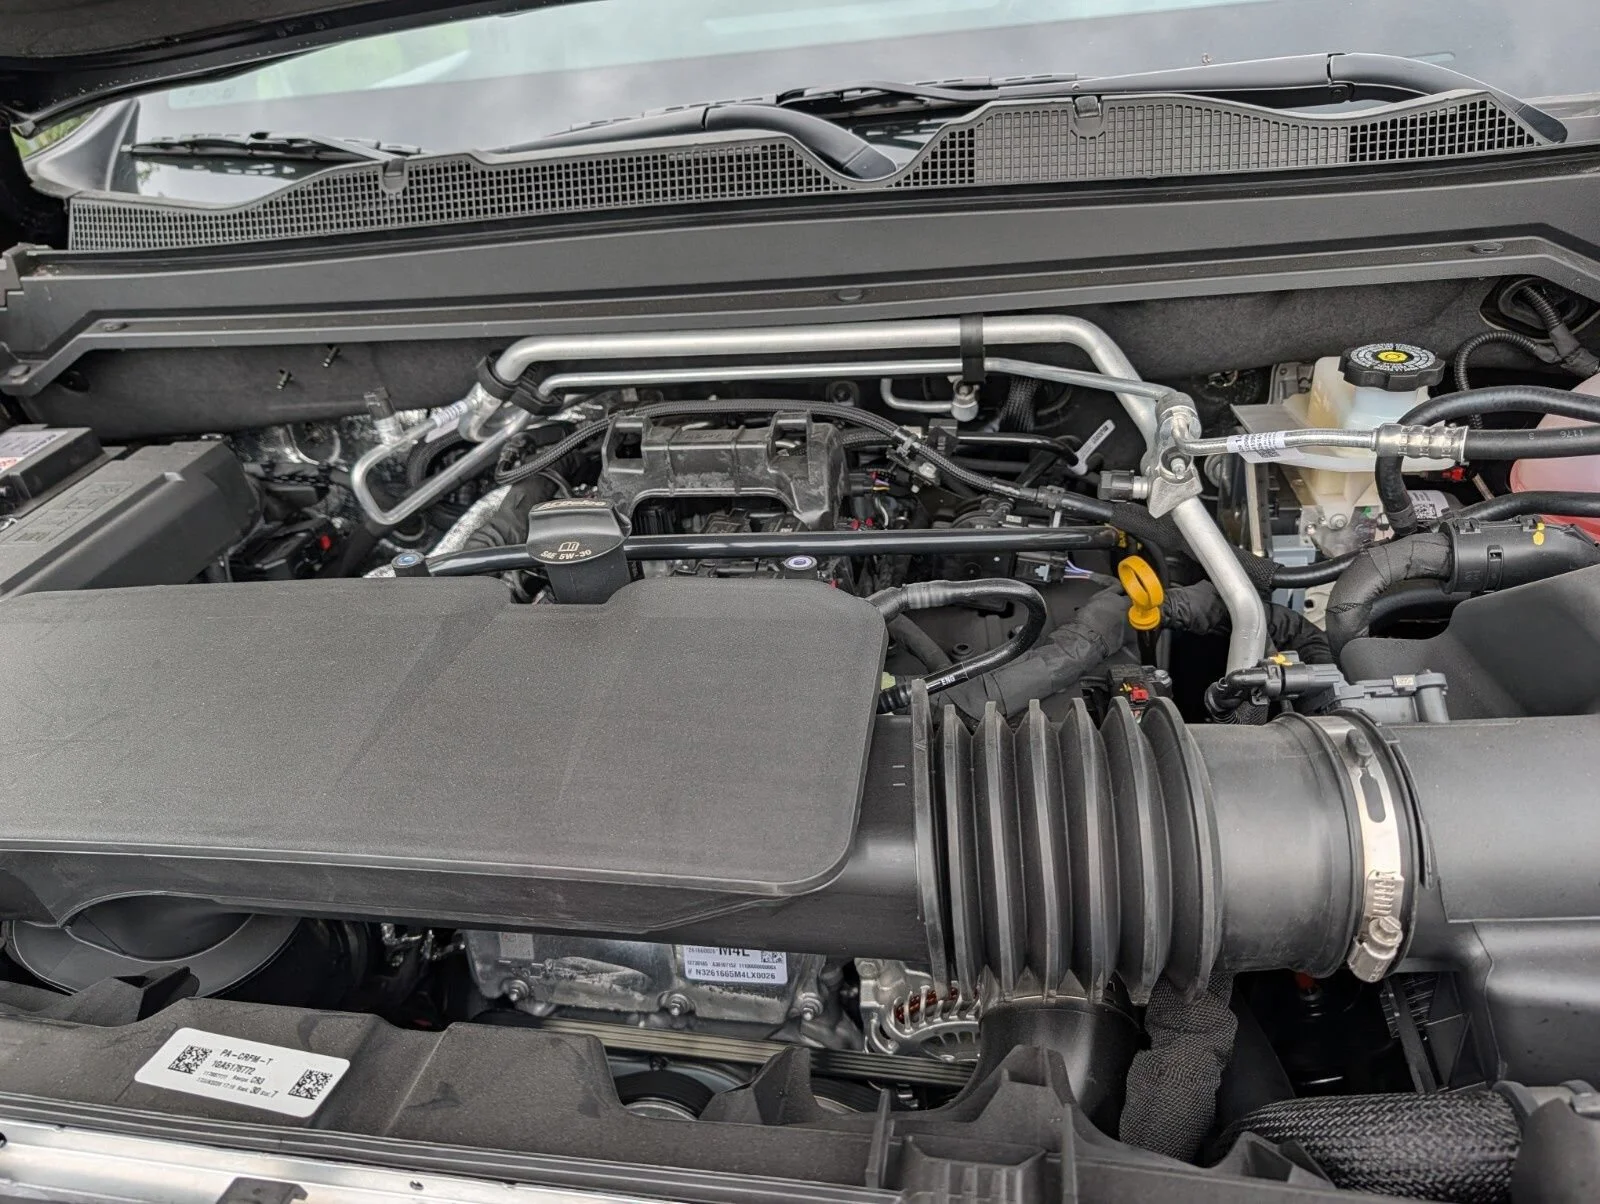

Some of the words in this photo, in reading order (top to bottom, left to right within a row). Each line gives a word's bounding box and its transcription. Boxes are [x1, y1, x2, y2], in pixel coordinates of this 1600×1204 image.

[540, 551, 557, 560] SAE
[559, 550, 592, 560] 5W-30
[941, 675, 956, 686] ENG
